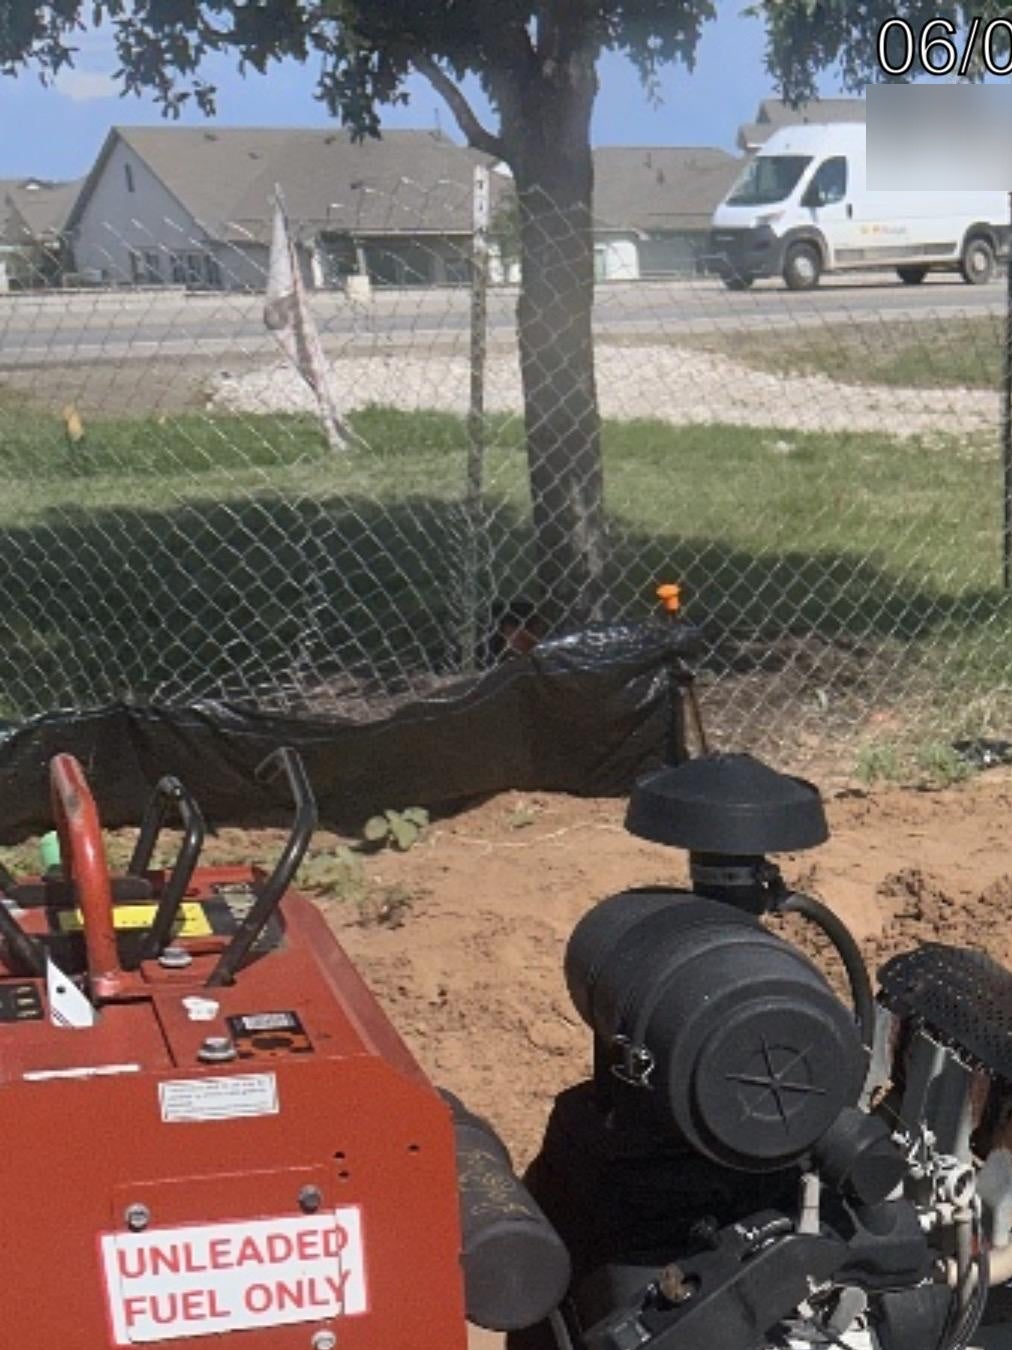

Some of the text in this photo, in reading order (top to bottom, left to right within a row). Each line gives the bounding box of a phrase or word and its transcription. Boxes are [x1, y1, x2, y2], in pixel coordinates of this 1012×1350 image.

[116, 1224, 350, 1280] UNLEADED
[123, 1269, 351, 1327] FUEL ONLY
